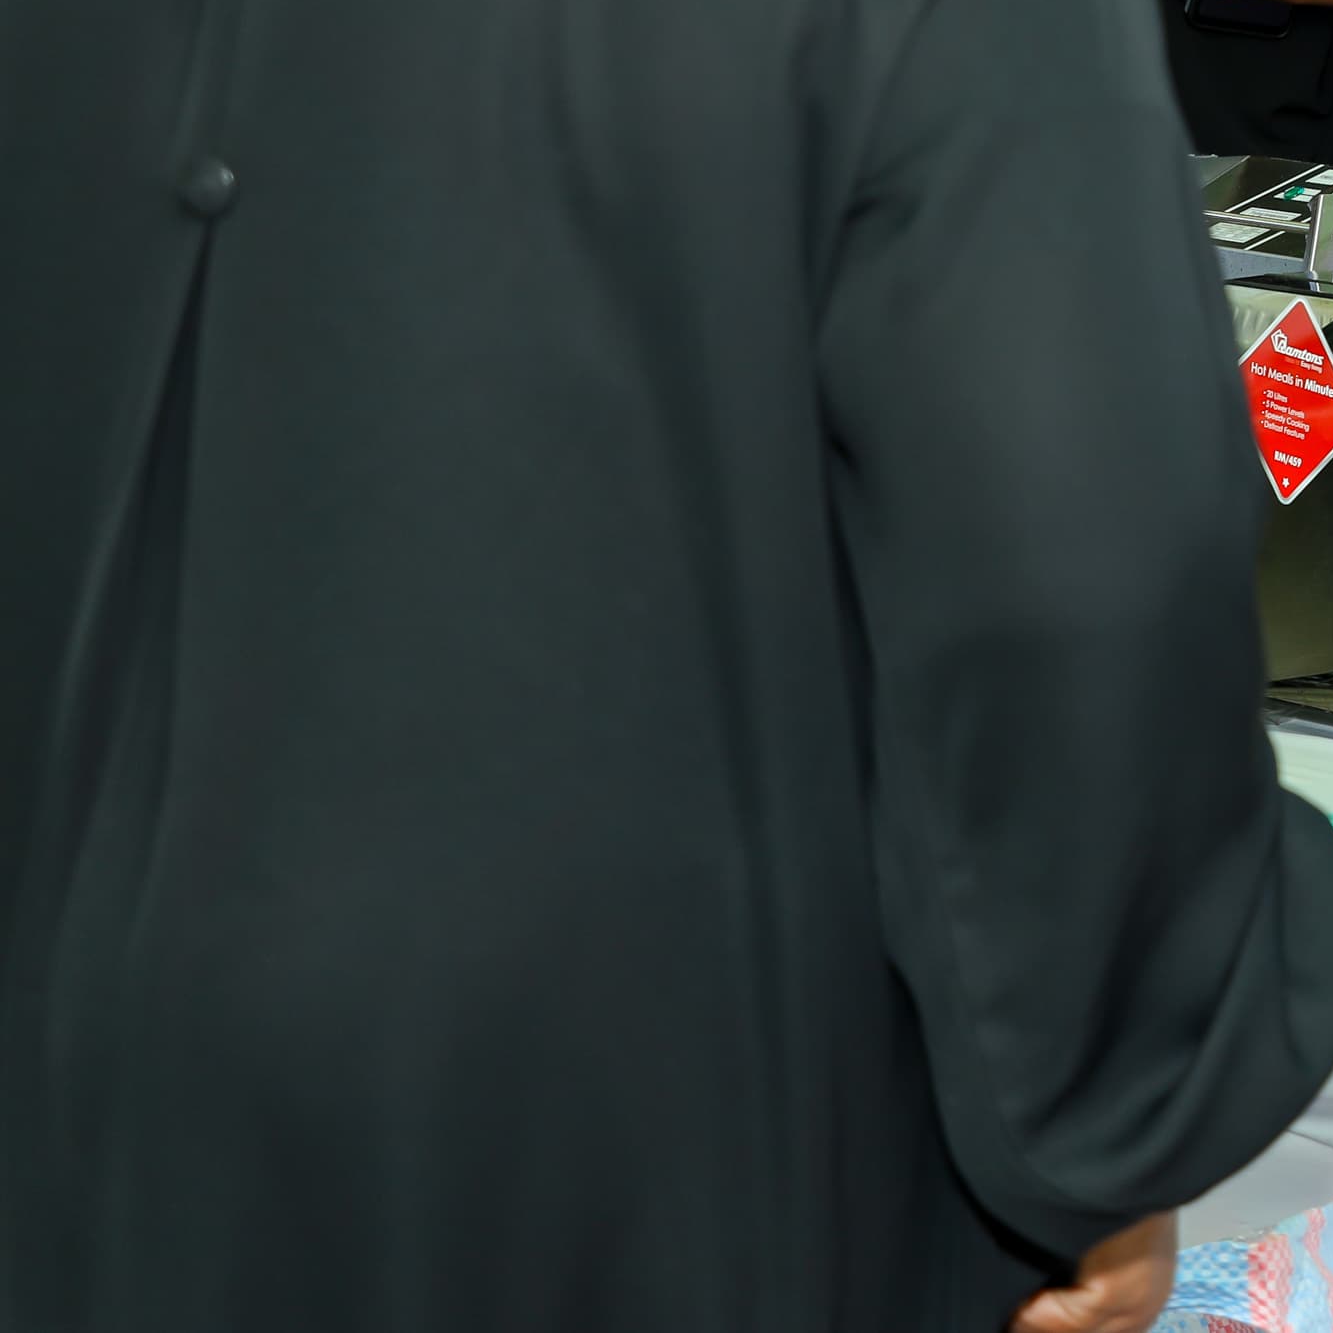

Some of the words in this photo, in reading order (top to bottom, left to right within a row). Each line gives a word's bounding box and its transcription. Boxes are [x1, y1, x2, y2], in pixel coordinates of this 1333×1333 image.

[1271, 329, 1324, 365] Ramtons
[1250, 362, 1266, 376] Hot
[1267, 367, 1294, 385] Meals
[1295, 374, 1303, 388] in
[1264, 410, 1286, 424] Speedy
[1286, 417, 1310, 432] Cooking
[1270, 401, 1288, 414] Power
[1287, 406, 1305, 419] Levels
[1274, 450, 1302, 468] RM/459
